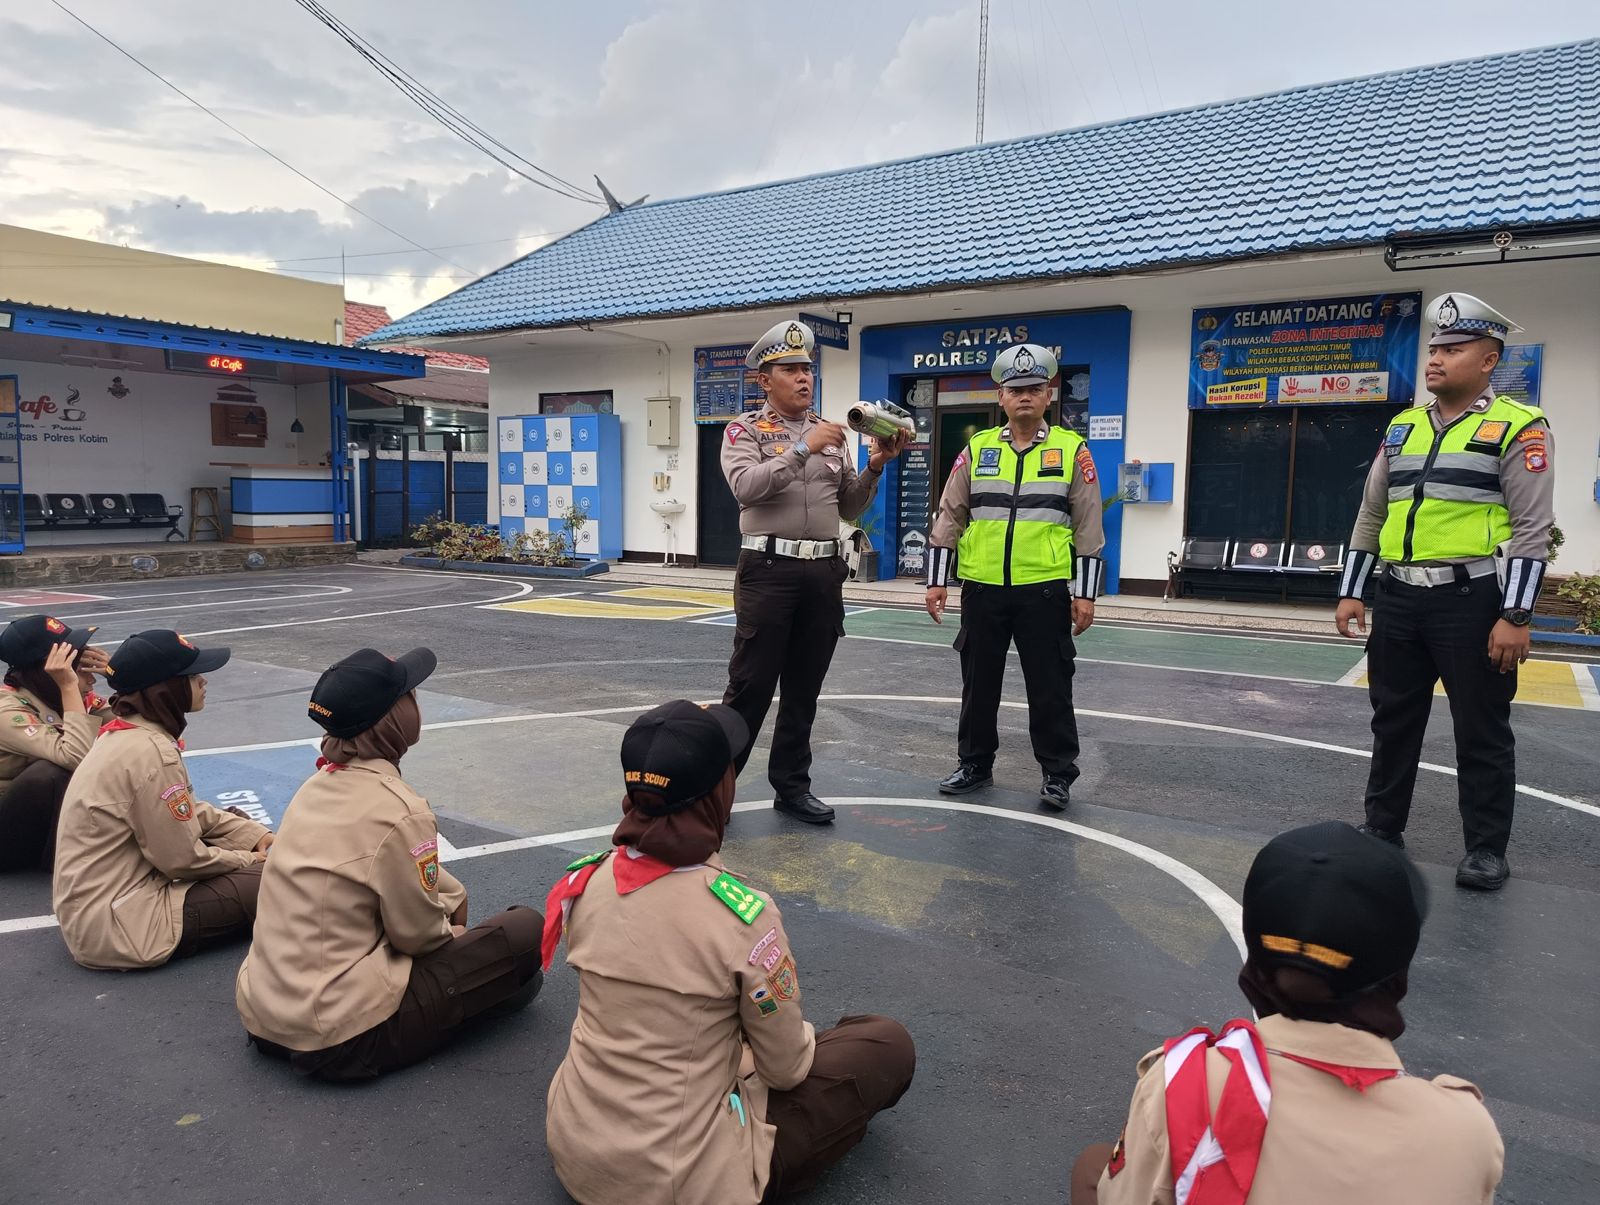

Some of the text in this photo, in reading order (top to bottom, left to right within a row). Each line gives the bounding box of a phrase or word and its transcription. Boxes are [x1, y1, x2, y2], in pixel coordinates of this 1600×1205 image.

[1234, 302, 1373, 328] SELAMAT DATANG
[942, 325, 1028, 348] SATPAS
[1222, 324, 1384, 346] DI KAWASAN ZONA INTEGRITAS
[734, 349, 750, 357] PELAY
[1248, 346, 1274, 356] POLRES
[1274, 344, 1328, 354] KOTAWARINGIN
[1329, 343, 1352, 352] TIMUR
[210, 357, 220, 368] di
[914, 350, 987, 368] POLRES
[1247, 352, 1354, 364] WILAYAH BEBAS KORUPSI (WBK)
[1222, 362, 1378, 376] WILAYAH BIROKRASI BERSIH MELAYANI (WBBM)
[1209, 382, 1260, 394] Hasil Korupsi
[18, 395, 58, 420] afe
[44, 432, 75, 442] Polres
[80, 434, 108, 443] Kotim
[760, 432, 791, 442] ALFIEN
[315, 704, 332, 718] SCOUT
[644, 772, 670, 788] SCOUT
[766, 949, 779, 967] 270
